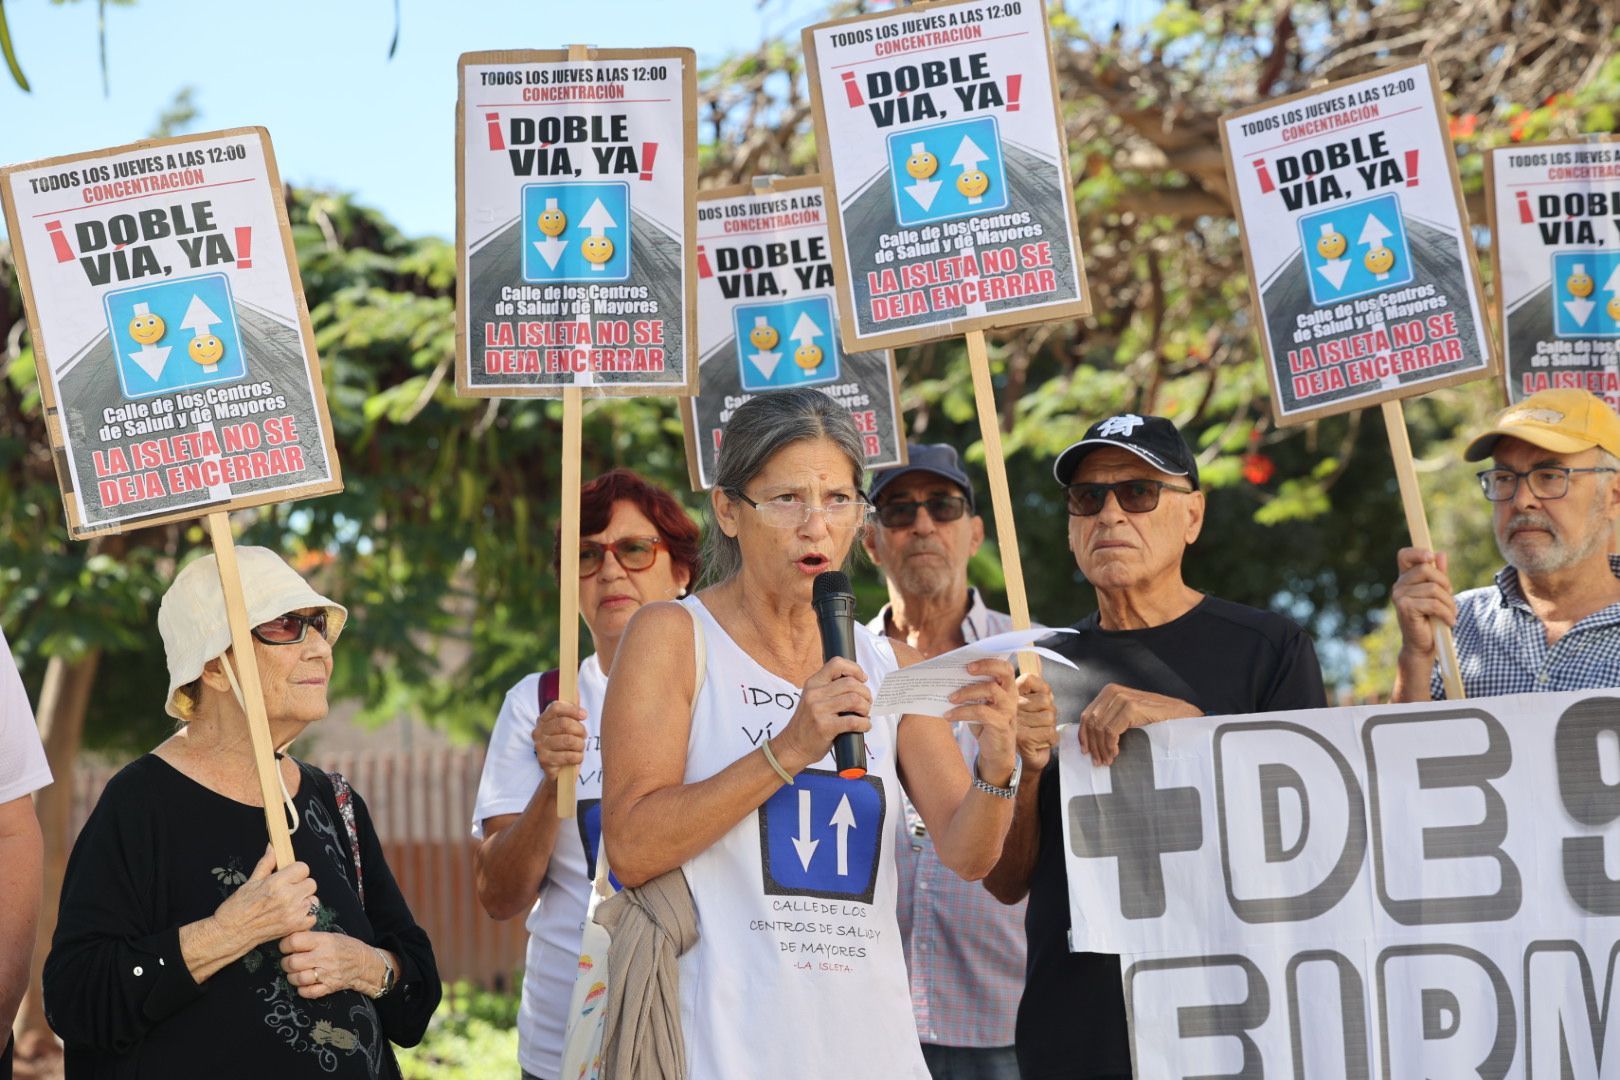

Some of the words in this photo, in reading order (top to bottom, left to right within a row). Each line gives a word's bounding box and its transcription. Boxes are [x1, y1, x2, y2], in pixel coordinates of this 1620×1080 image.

[830, 28, 874, 47] TODOS
[877, 23, 901, 39] LOS
[903, 15, 947, 35] JUEVES
[950, 13, 959, 26] A
[959, 8, 982, 24] LAS
[985, 1, 1021, 19] 12:00
[875, 25, 980, 56] CONCENTRACIÓN
[481, 71, 522, 85] TODOS
[526, 70, 549, 84] LOS
[552, 69, 593, 84] JUEVES
[597, 69, 605, 82] A
[607, 68, 628, 81] LAS
[632, 66, 666, 81] 12:00
[523, 84, 624, 101] CONCENTRACIÓN
[869, 89, 946, 127] VÍA,
[1240, 115, 1281, 137] TODOS
[1282, 108, 1305, 126] LOS
[1306, 96, 1346, 119] JUEVES
[1349, 94, 1358, 107] A
[1357, 87, 1379, 104] LAS
[1381, 77, 1415, 98] 12:00
[1282, 104, 1378, 142] CONCENTRACIÓN
[30, 169, 82, 191] TODOS
[84, 164, 113, 183] LOS
[114, 156, 164, 178] JUEVES
[167, 155, 178, 170] A
[177, 150, 204, 168] LAS
[206, 143, 247, 163] 12:00
[509, 141, 581, 178] VÍA,
[1508, 154, 1547, 167] TODOS
[1551, 152, 1571, 164] LOS
[1575, 150, 1611, 163] JUEVES
[84, 169, 203, 202] CONCENTRACIÓN
[1280, 172, 1350, 212] VÍA,
[699, 207, 722, 220] DOS
[725, 204, 746, 217] LOS
[750, 201, 788, 215] JUEVES
[791, 198, 799, 209] A
[801, 195, 822, 207] LAS
[724, 210, 819, 233] CONCENTRACIÓN
[874, 250, 894, 264] de
[897, 240, 943, 260] Salud
[942, 240, 949, 253] y
[953, 235, 973, 250] de
[976, 224, 1042, 246] Mayores
[879, 230, 920, 248] Calle
[923, 226, 941, 241] de
[942, 223, 966, 237] los
[968, 212, 1030, 233] Centros
[1538, 215, 1604, 246] VÍA,
[81, 242, 170, 285] VÍA,
[866, 268, 900, 295] LA
[900, 254, 979, 289] ISLETA
[981, 247, 1017, 275] NO
[1019, 241, 1053, 269] SE
[502, 286, 540, 300] Calle
[544, 286, 560, 300] de
[563, 286, 585, 299] los
[589, 285, 647, 299] Centros
[717, 267, 787, 299] VÍA,
[869, 290, 930, 322] DEJA
[932, 268, 1057, 311] ENCERRAR
[495, 302, 513, 315] de
[518, 301, 561, 315] Salud
[561, 303, 568, 316] y
[572, 300, 590, 314] de
[594, 300, 657, 315] Mayores
[1293, 329, 1311, 343] de
[1313, 316, 1356, 338] Salud
[1354, 316, 1361, 329] y
[1364, 311, 1383, 325] de
[1385, 296, 1447, 320] Mayores
[1296, 309, 1334, 328] Calle
[1336, 304, 1353, 318] de
[1353, 299, 1376, 314] los
[1377, 284, 1435, 308] Centros
[485, 322, 515, 346] LA
[518, 321, 592, 346] ISLETA
[597, 321, 629, 345] NO
[634, 320, 664, 345] SE
[1287, 346, 1318, 374] LA
[1317, 329, 1390, 366] ISLETA
[1391, 319, 1425, 349] NO
[1426, 311, 1458, 340] SE
[1536, 341, 1572, 353] Calle
[1574, 340, 1591, 352] de
[485, 349, 541, 374] DEJA
[545, 348, 664, 373] ENCERRAR
[1291, 366, 1347, 400] DEJA
[1347, 337, 1463, 386] ENCERRAR
[1531, 354, 1549, 366] de
[1551, 353, 1590, 366] Salud
[1523, 372, 1549, 394] LA
[99, 426, 122, 442] de
[124, 414, 177, 437] Salud
[175, 414, 184, 429] y
[188, 409, 210, 425] de
[213, 396, 286, 420] Mayores
[102, 403, 150, 424] Calle
[153, 398, 173, 415] de
[174, 395, 202, 411] los
[203, 382, 272, 405] Centros
[91, 446, 131, 478] LA
[129, 430, 220, 471] ISLETA
[220, 421, 262, 453] NO
[262, 414, 300, 446] SE
[97, 470, 167, 509] DEJA
[167, 444, 306, 495] ENCERRAR
[749, 920, 817, 933] CENTROS
[819, 923, 833, 935] DE
[842, 905, 867, 918] LOS
[780, 941, 797, 953] DE
[800, 943, 867, 959] MAYORES
